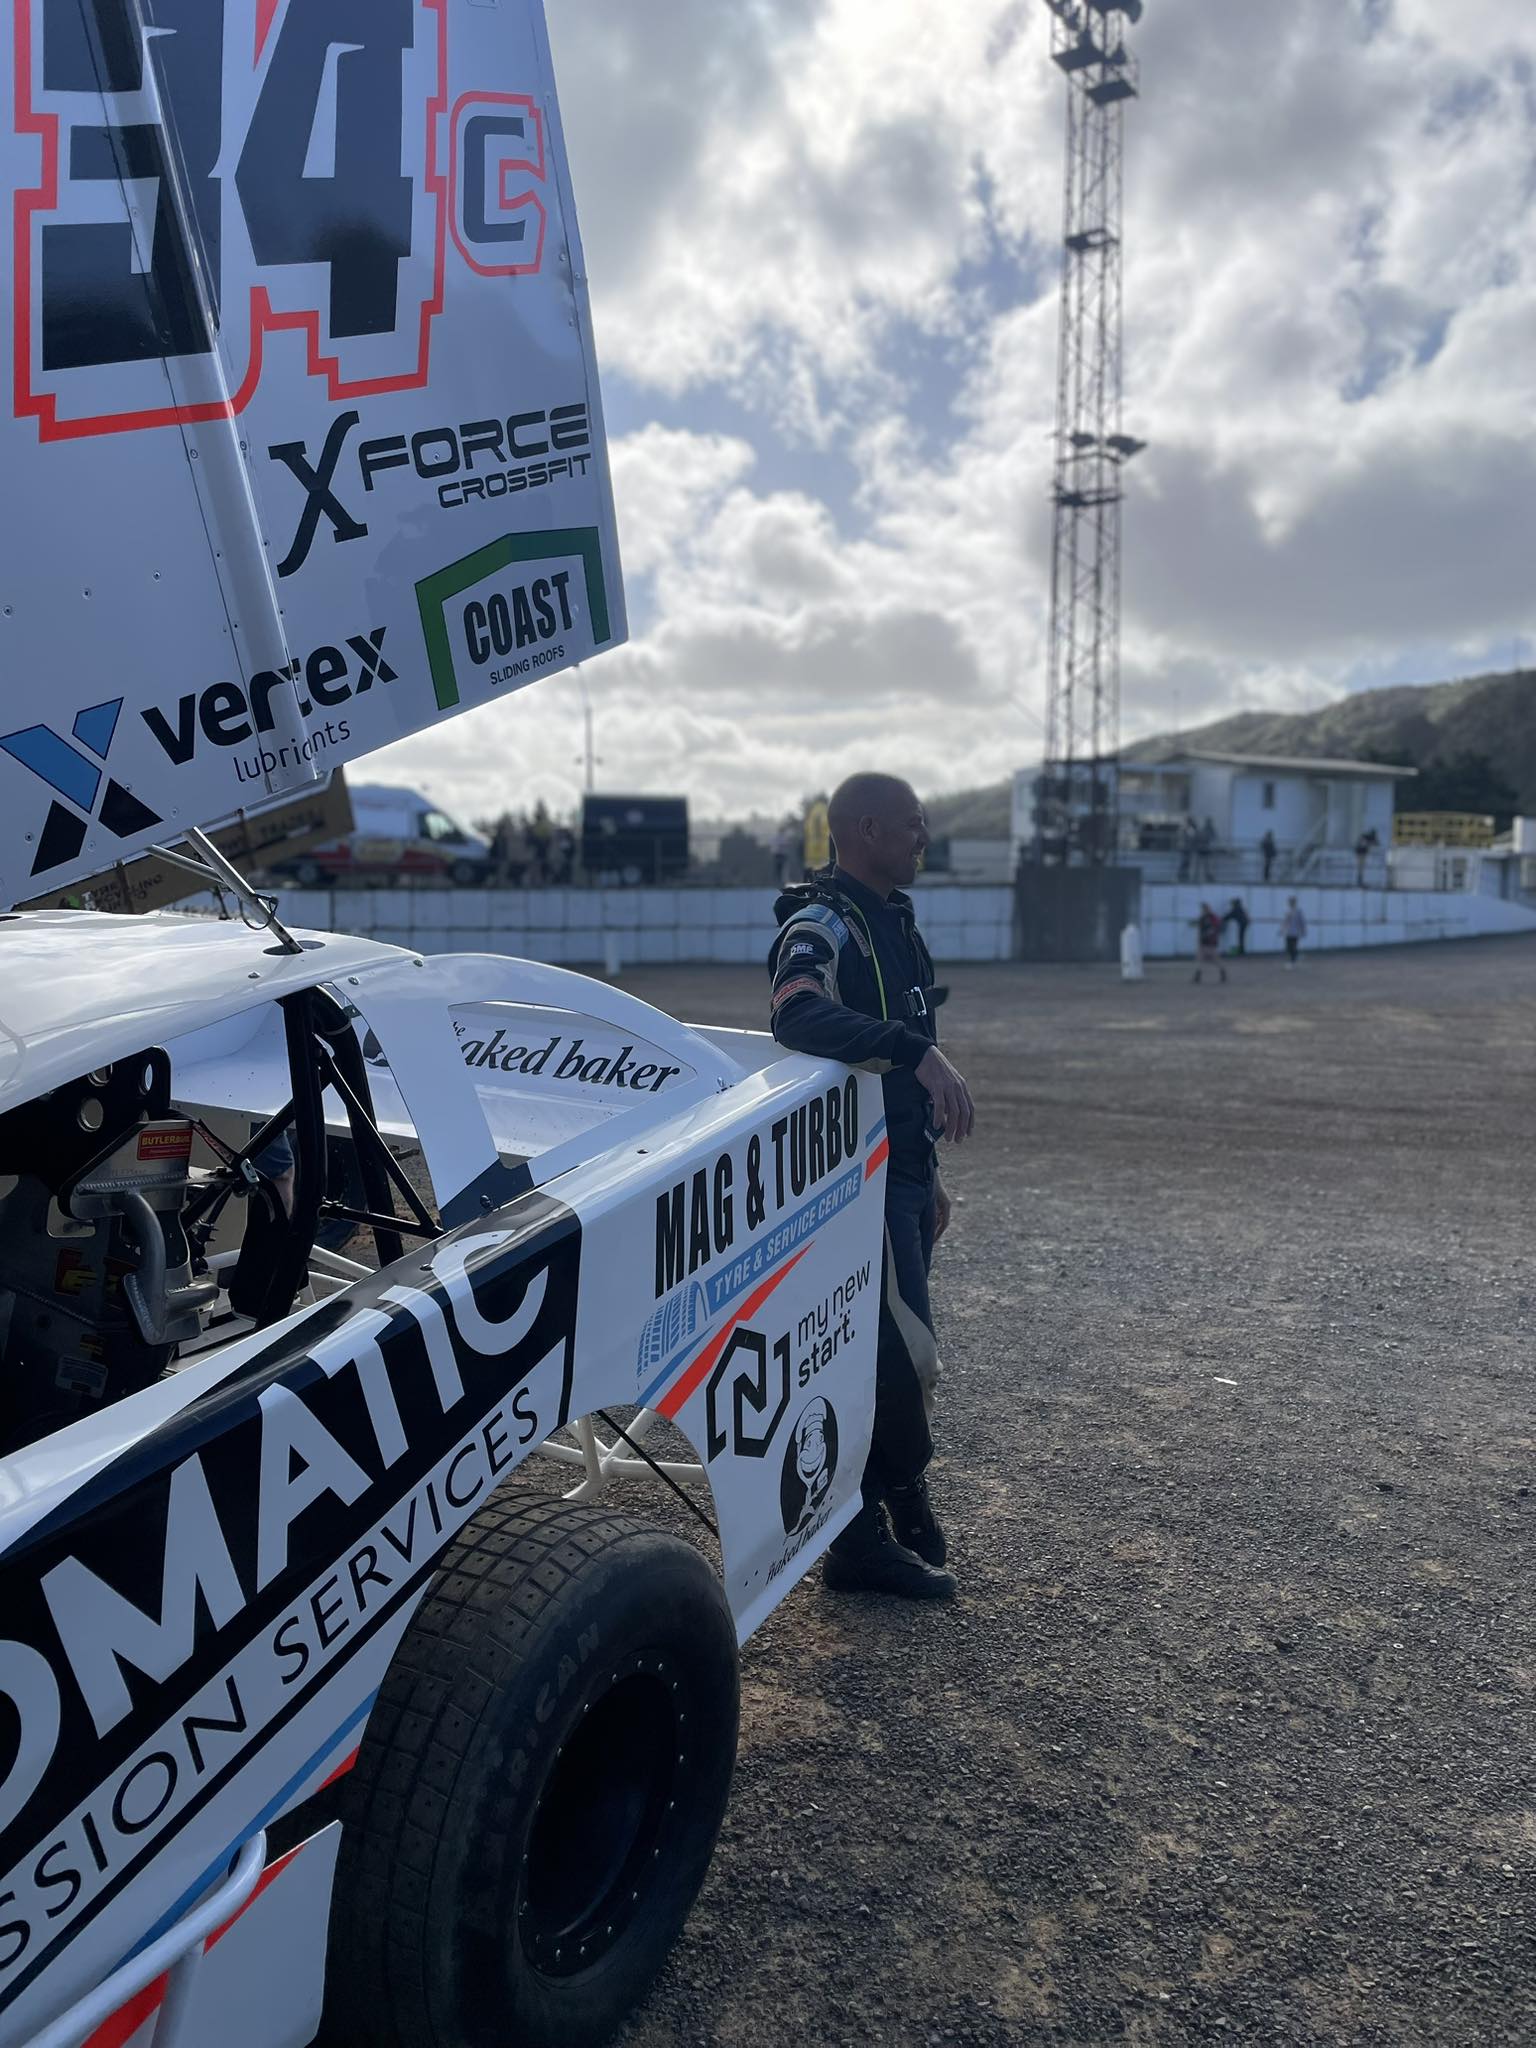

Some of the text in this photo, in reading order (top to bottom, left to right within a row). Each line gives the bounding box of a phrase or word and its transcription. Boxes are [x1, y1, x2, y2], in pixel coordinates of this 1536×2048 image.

[437, 452, 592, 508] CROSSFIT
[463, 570, 573, 665] COAST
[489, 644, 566, 685] SLIDING ROOFS
[553, 1038, 681, 1093] baker
[655, 1074, 858, 1301] MAG & TURBO
[715, 1172, 860, 1304] TYRE & SERVICE CENTRE
[798, 1260, 871, 1348] my new
[272, 1386, 539, 1686] SERVICES
